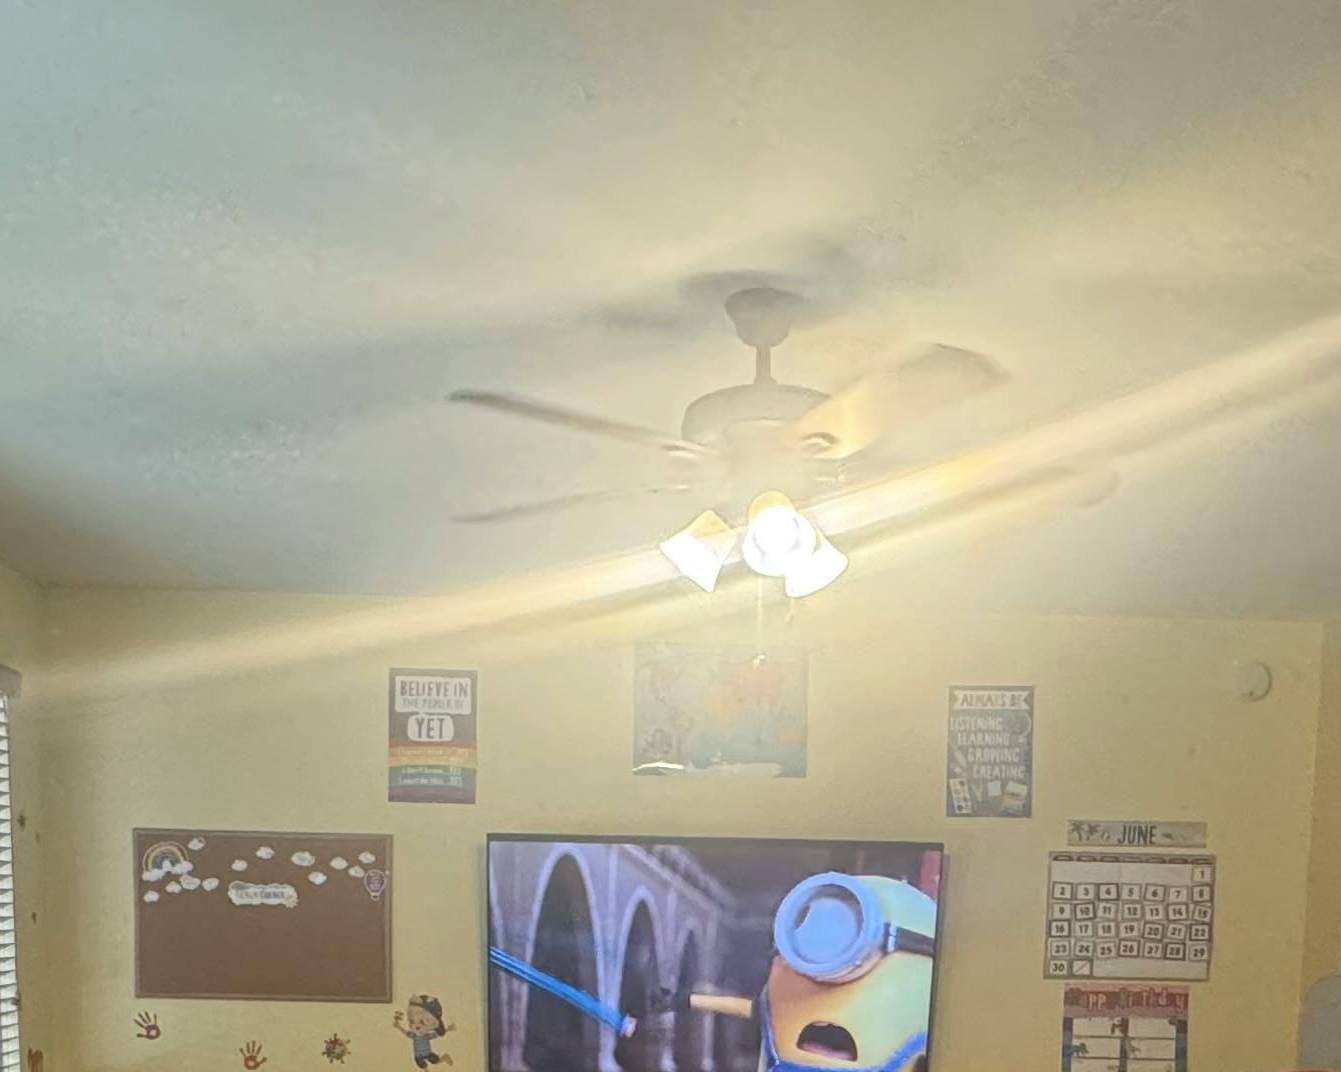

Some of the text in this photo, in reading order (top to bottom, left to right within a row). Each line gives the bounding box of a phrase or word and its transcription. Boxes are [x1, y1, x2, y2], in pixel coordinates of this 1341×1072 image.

[400, 680, 468, 698] BELIEVE IN
[415, 718, 445, 739] YET
[1117, 825, 1157, 844] JUNE
[1080, 907, 1090, 916] 10
[1103, 906, 1112, 915] 11
[1128, 907, 1137, 916] 12
[1150, 908, 1159, 917] 13
[1172, 908, 1182, 917] 14
[1198, 910, 1208, 919] 15
[1055, 925, 1206, 937] 16 17 18 19 20 21 22
[1055, 944, 1205, 957] 23 24 25 26 27 28 29
[1052, 964, 1064, 972] 30
